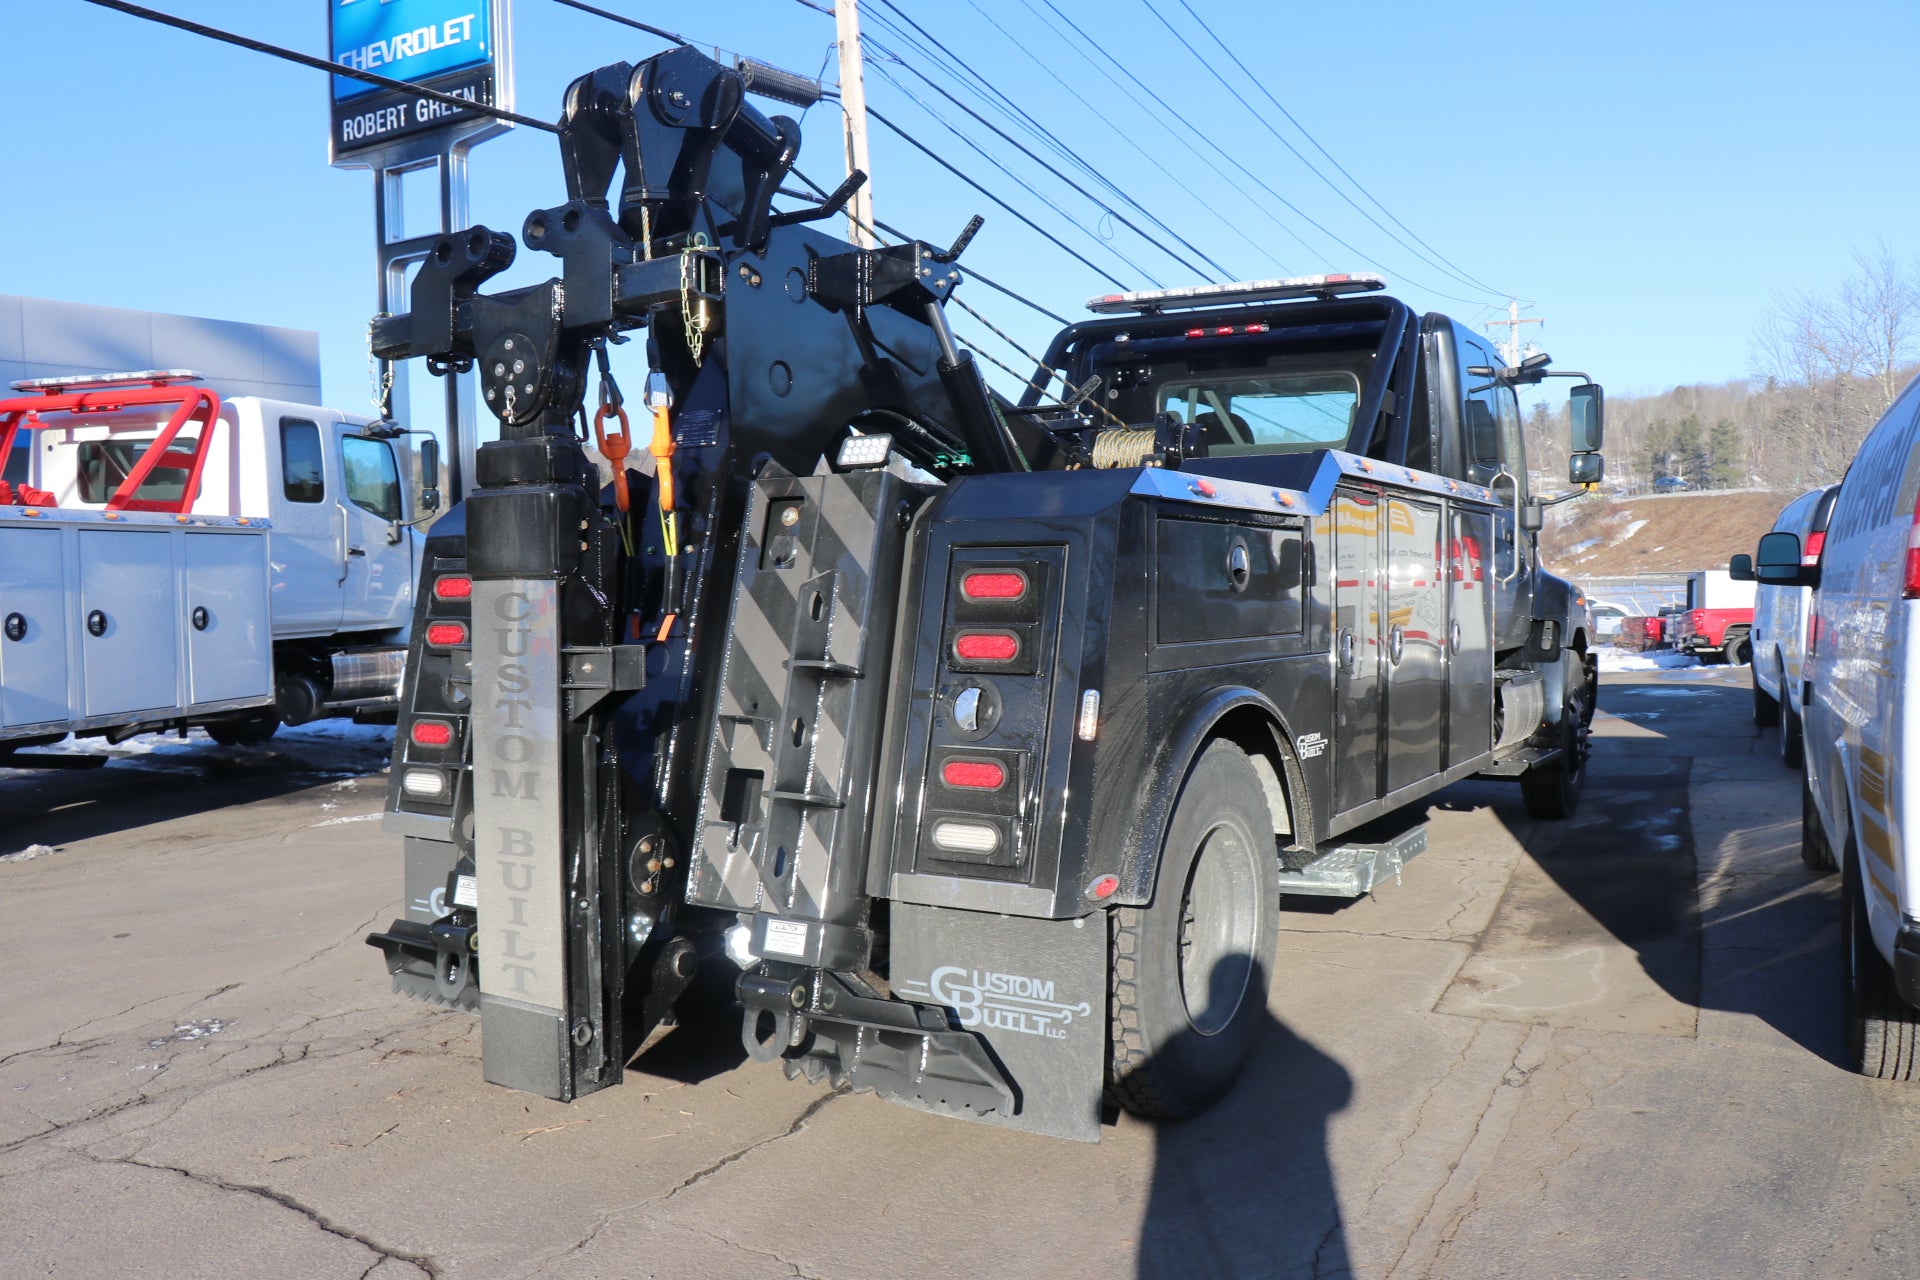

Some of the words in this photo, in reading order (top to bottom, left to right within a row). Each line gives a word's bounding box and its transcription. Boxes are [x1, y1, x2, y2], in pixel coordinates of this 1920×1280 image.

[338, 13, 475, 76] CHEVROLET
[343, 104, 407, 142] ROBERT
[493, 592, 540, 800] CUSTOM
[498, 826, 537, 995] BUILT
[1045, 1028, 1067, 1040] LLC
